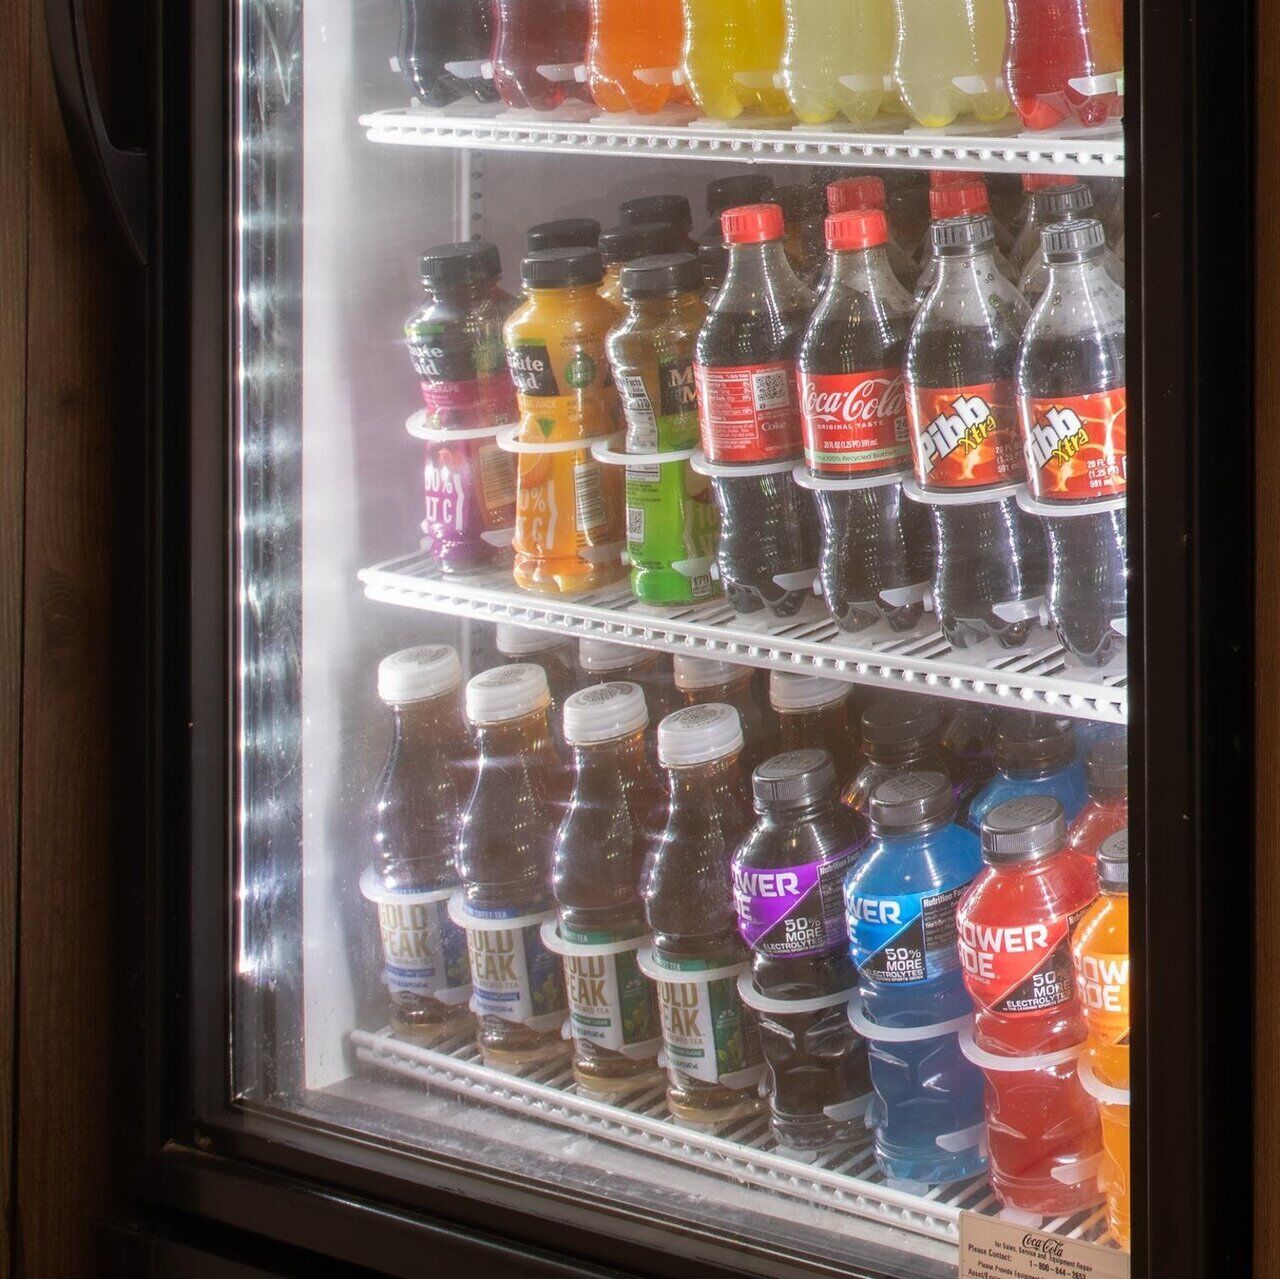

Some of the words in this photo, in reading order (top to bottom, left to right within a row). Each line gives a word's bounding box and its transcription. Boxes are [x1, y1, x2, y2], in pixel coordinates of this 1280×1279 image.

[857, 420, 884, 429] TASTE
[924, 893, 952, 907] Nutrition
[785, 918, 821, 933] 50%
[786, 927, 822, 943] MORE
[885, 948, 922, 962] 50%
[886, 959, 922, 972] MORE
[1032, 969, 1069, 988] 50%
[1034, 980, 1070, 998] MORE
[1007, 990, 1072, 1008] ELECTROLYTES
[968, 1243, 987, 1256] Please
[988, 1249, 1012, 1262] Contact:
[1019, 1246, 1036, 1257] Service
[1037, 1252, 1047, 1261] and
